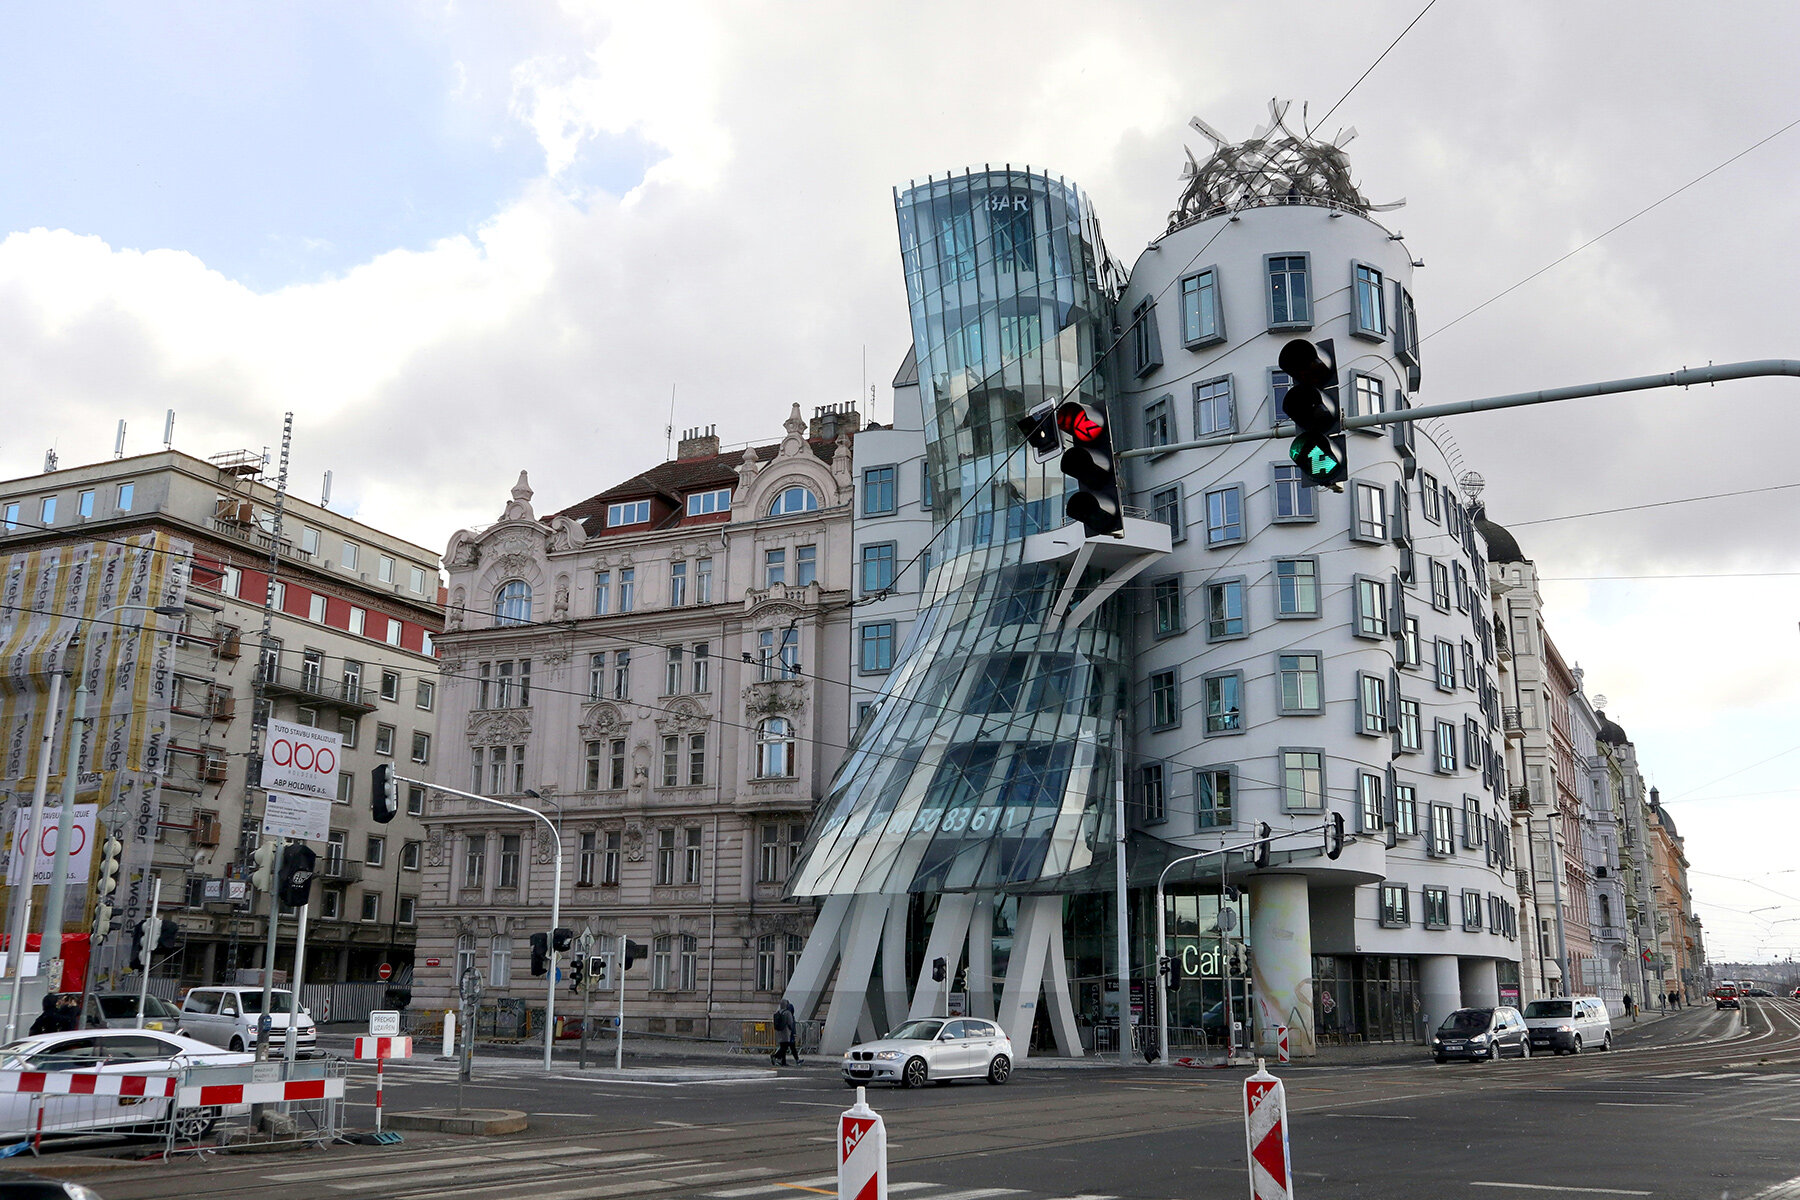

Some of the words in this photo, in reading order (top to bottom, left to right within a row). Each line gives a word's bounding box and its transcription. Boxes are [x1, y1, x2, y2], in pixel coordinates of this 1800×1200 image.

[984, 194, 1029, 211] BAR
[70, 562, 84, 611] weber
[102, 559, 117, 610] weber
[89, 644, 103, 696] weber
[121, 637, 135, 691] weber
[155, 646, 168, 698] weber
[11, 725, 25, 775] weber
[147, 733, 160, 767] web
[274, 725, 289, 734] TUTO
[290, 728, 310, 738] STAVBU
[274, 778, 287, 786] ABP
[288, 781, 316, 792] HOLDING
[137, 789, 153, 844] weber
[126, 882, 140, 937] weber
[1250, 1084, 1269, 1110] AZ
[845, 1122, 864, 1155] AZ
